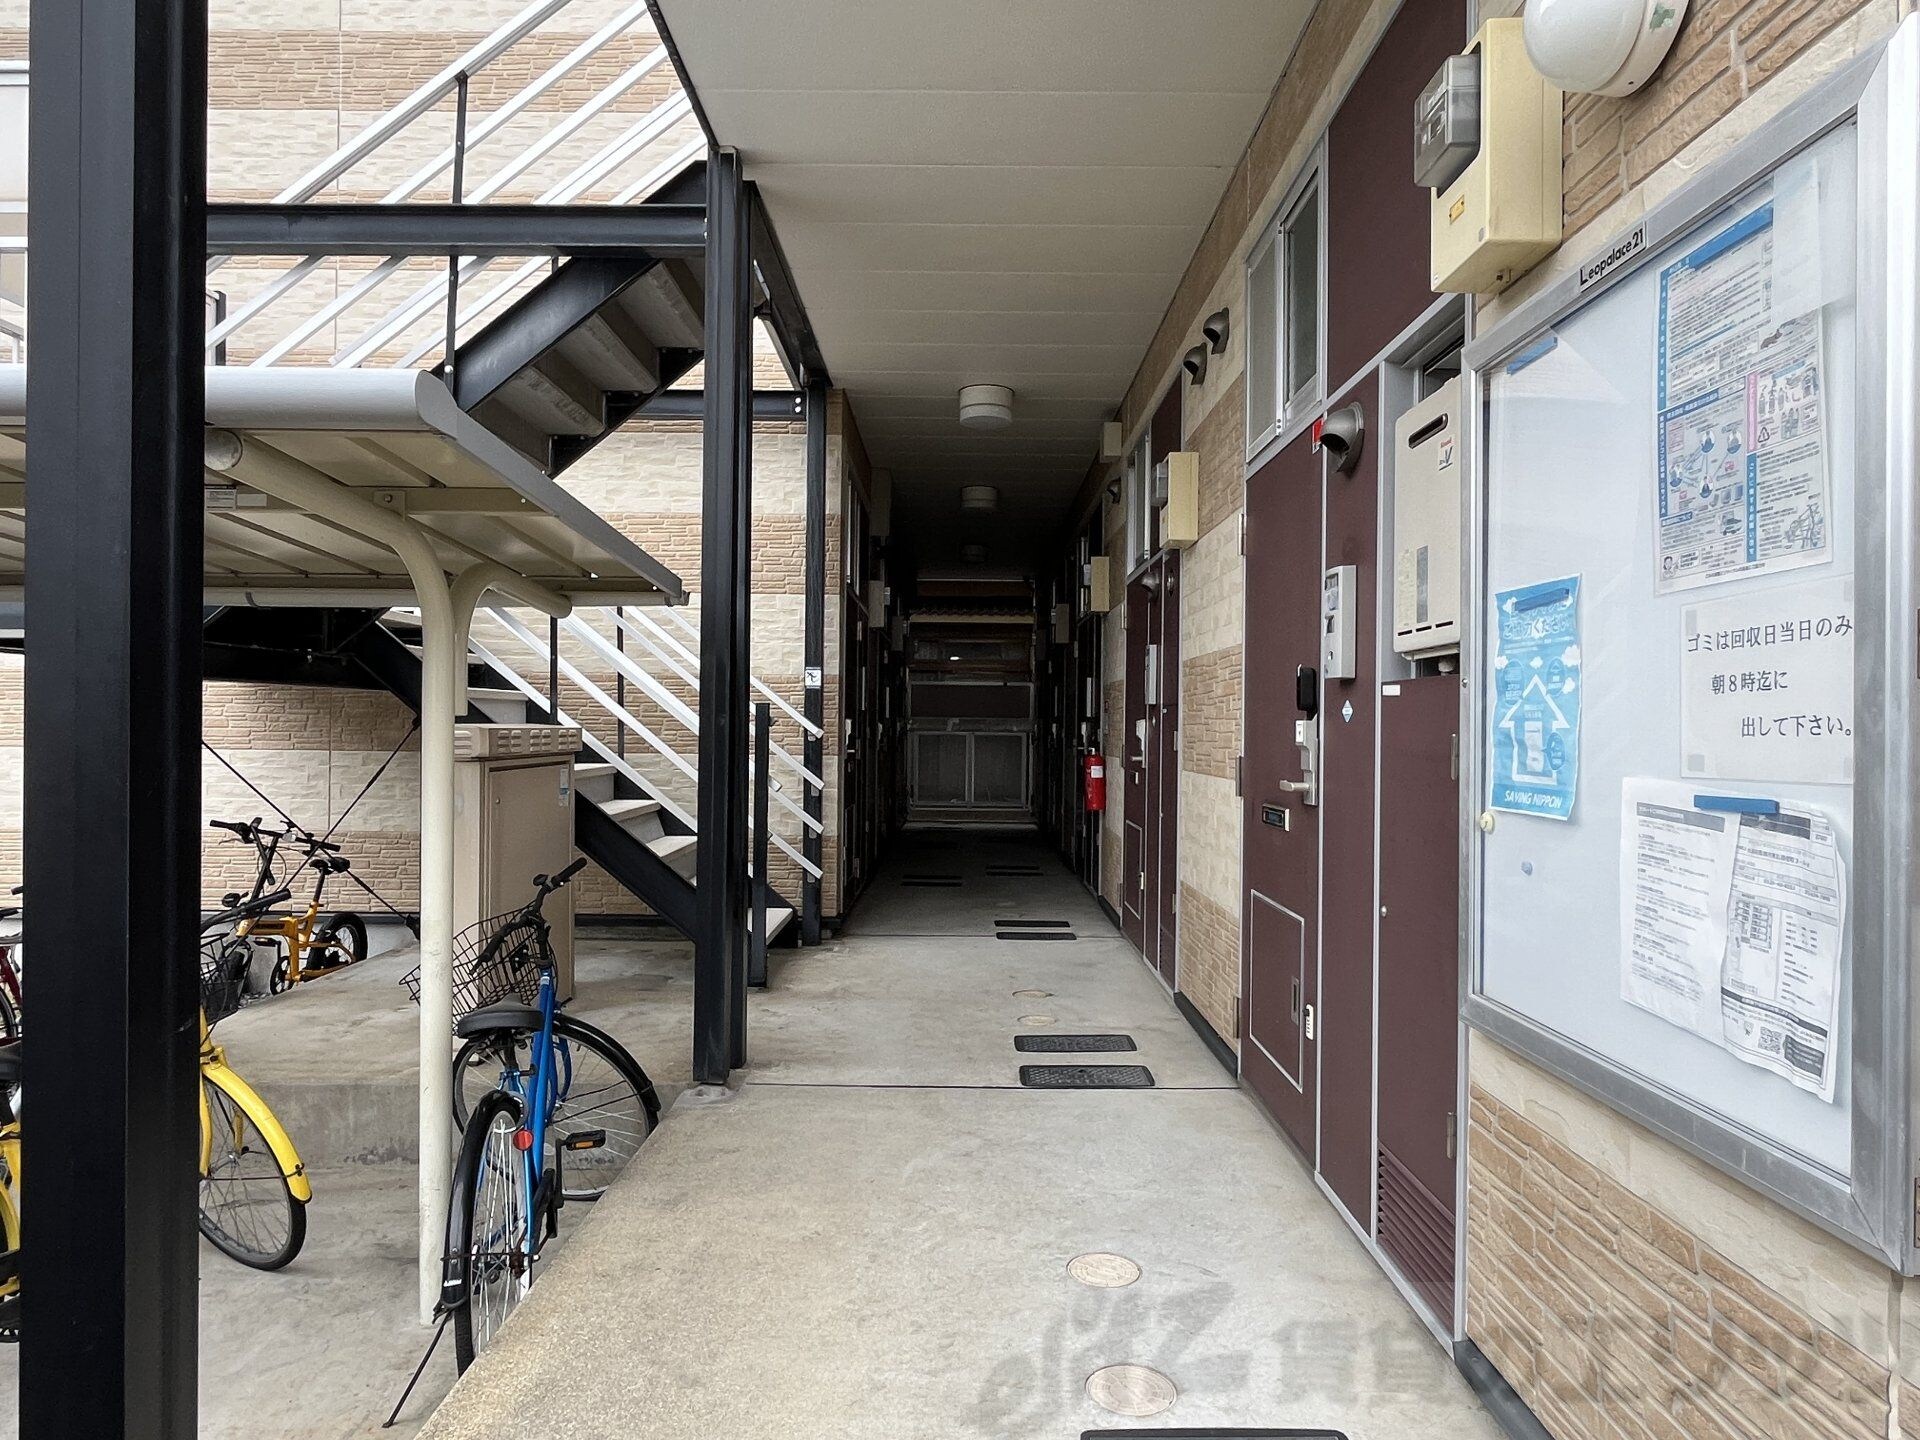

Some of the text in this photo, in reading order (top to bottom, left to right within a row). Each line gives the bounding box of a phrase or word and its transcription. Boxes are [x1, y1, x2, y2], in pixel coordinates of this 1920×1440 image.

[1687, 615, 1853, 653] ゴミは回収日当日のみ
[1741, 715, 1852, 739] 出して下さい。
[1504, 790, 1563, 809] SAVING NIPPON
